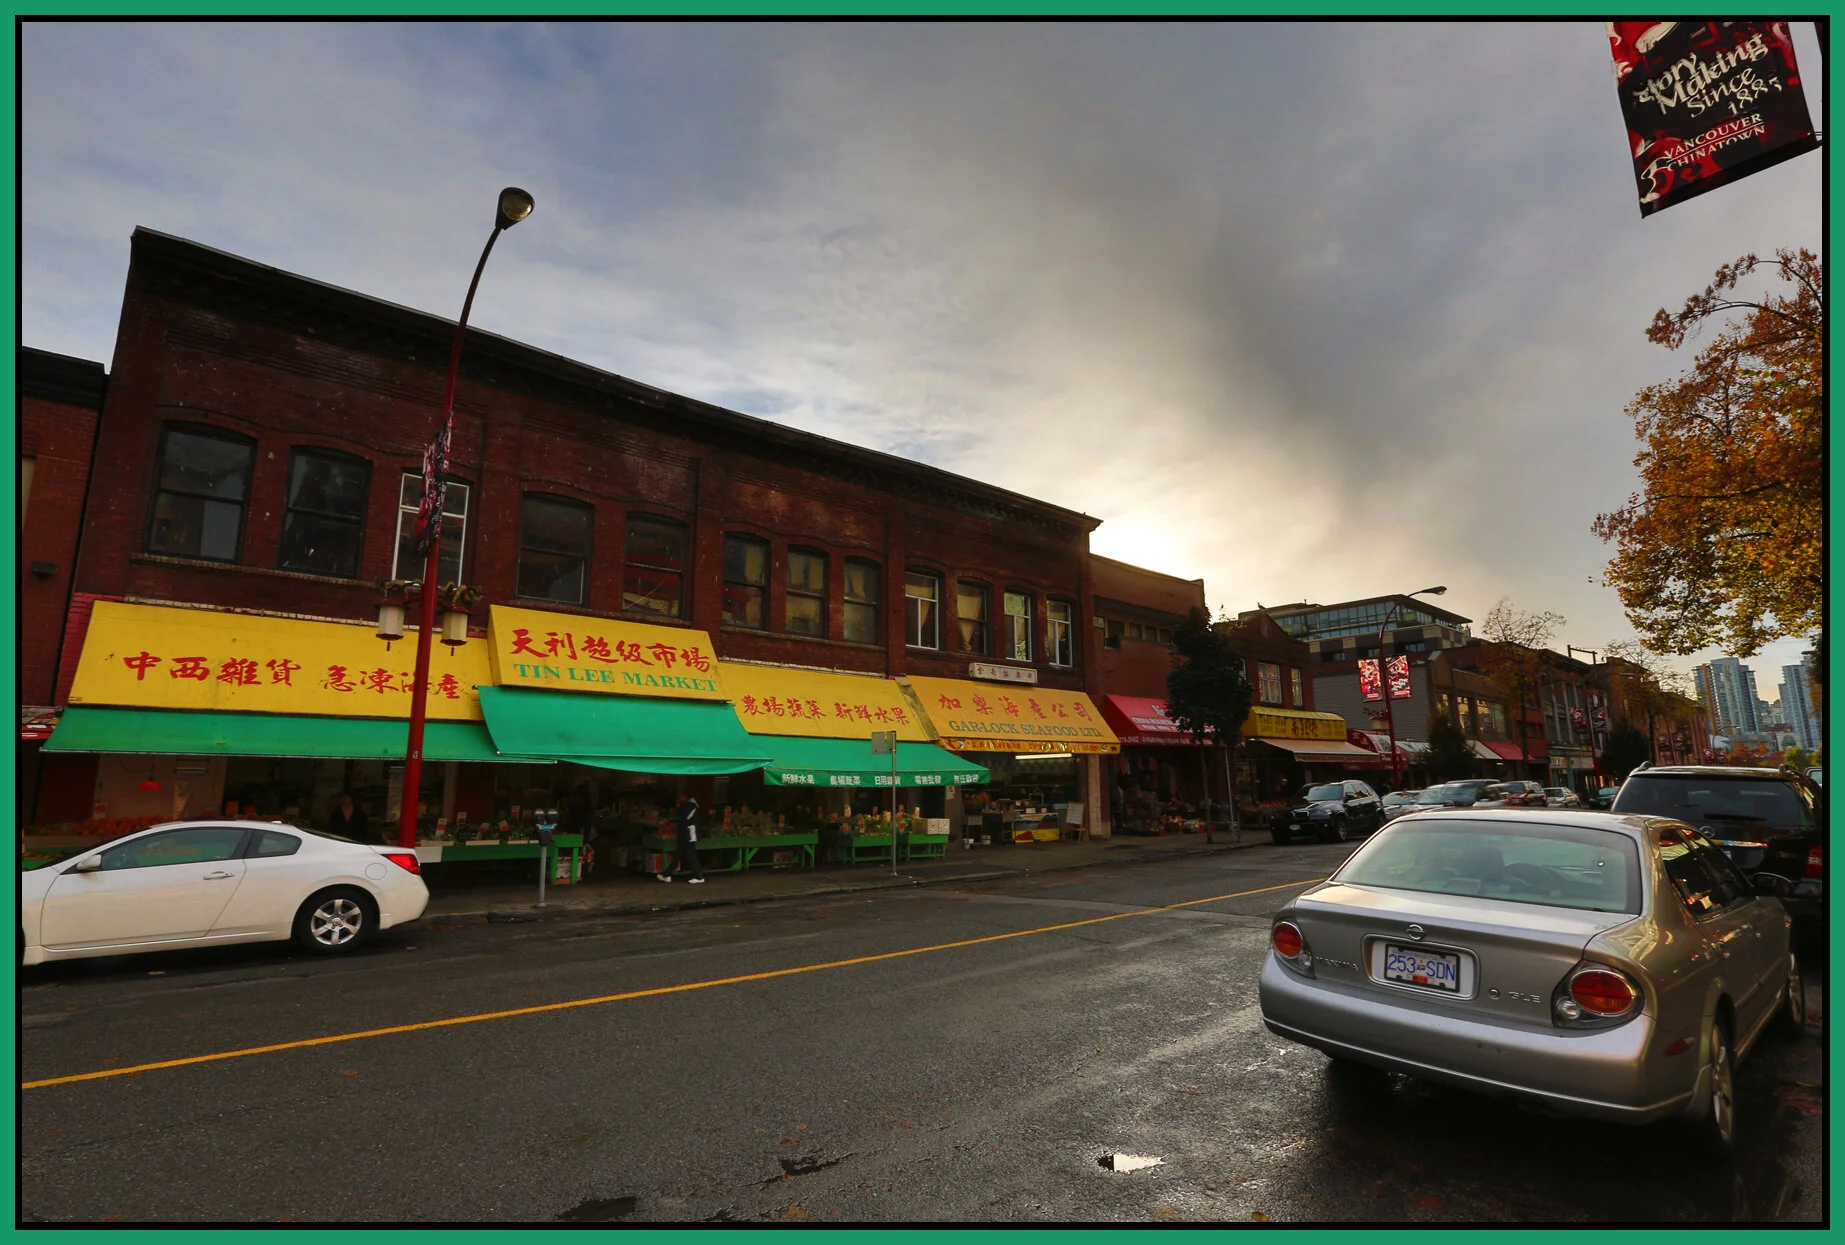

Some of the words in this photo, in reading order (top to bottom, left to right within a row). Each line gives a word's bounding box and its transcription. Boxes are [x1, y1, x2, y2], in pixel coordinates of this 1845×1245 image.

[1657, 34, 1768, 115] Making
[1687, 68, 1755, 118] Since
[1728, 77, 1783, 115] 1885
[1664, 113, 1763, 158] VANCOUVER
[1667, 125, 1765, 171] CHINATOWN
[123, 651, 301, 687] 中西雜貨
[514, 663, 560, 679] TIN
[568, 667, 615, 683] LEE
[622, 671, 719, 692] MARKET
[834, 702, 910, 725] 新鮮水果
[949, 720, 1020, 734] GAR-LOCK
[1020, 724, 1079, 736] SEAFOOD
[781, 774, 815, 785] 新鮮水果
